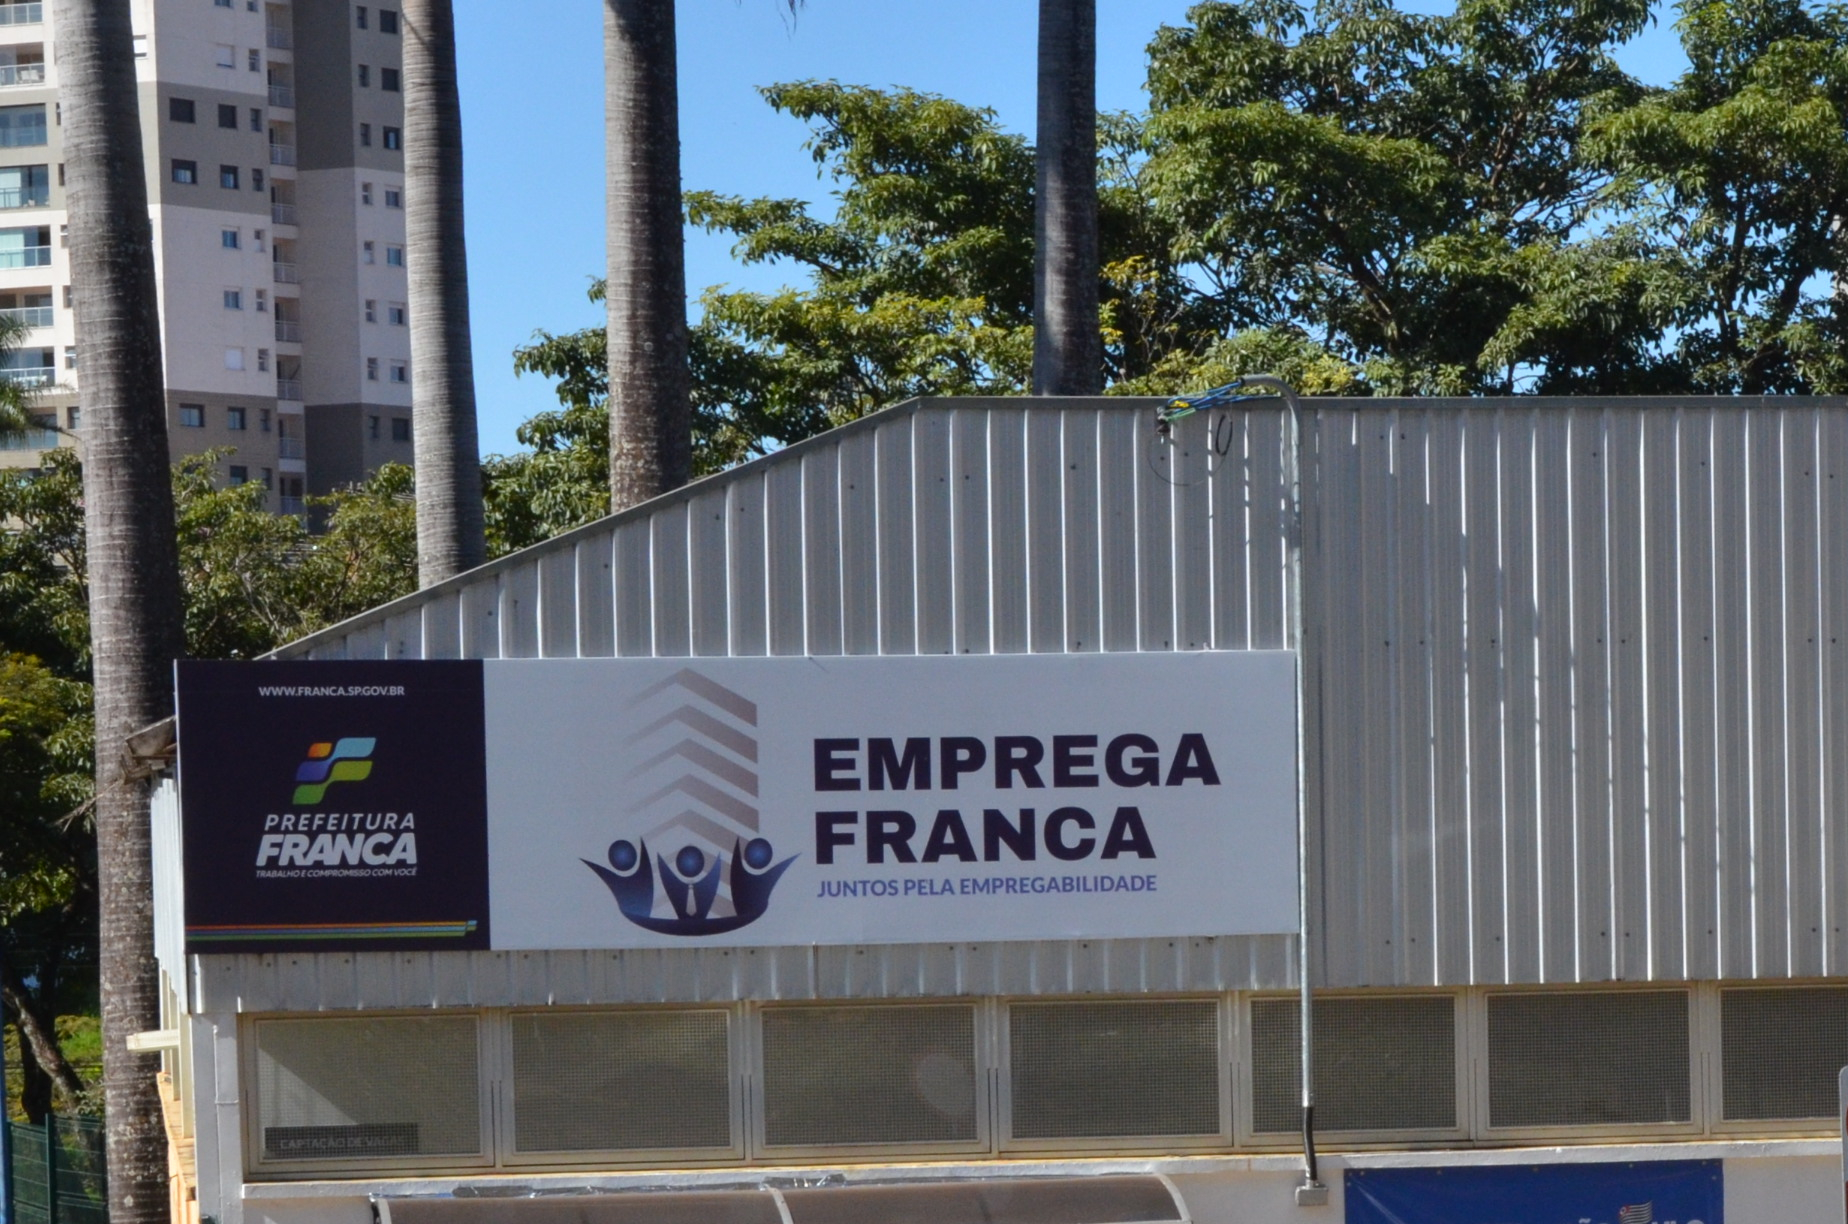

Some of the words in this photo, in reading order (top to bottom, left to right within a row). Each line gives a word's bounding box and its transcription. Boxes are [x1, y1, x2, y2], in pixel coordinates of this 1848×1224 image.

[258, 686, 405, 697] WWW.FRANCA.SP.GOV.BR
[813, 733, 1221, 792] EMPREGA
[264, 813, 415, 832] PREFEITURA
[815, 806, 1157, 865] FRANCA
[256, 833, 417, 867] FRANCA
[256, 870, 300, 878] TRABALHO
[307, 869, 371, 877] COMPROMISSO
[372, 868, 394, 876] COM
[817, 879, 899, 897] JUNTOS
[903, 878, 955, 896] PELA
[960, 875, 1157, 894] EMPREGABILIDADE
